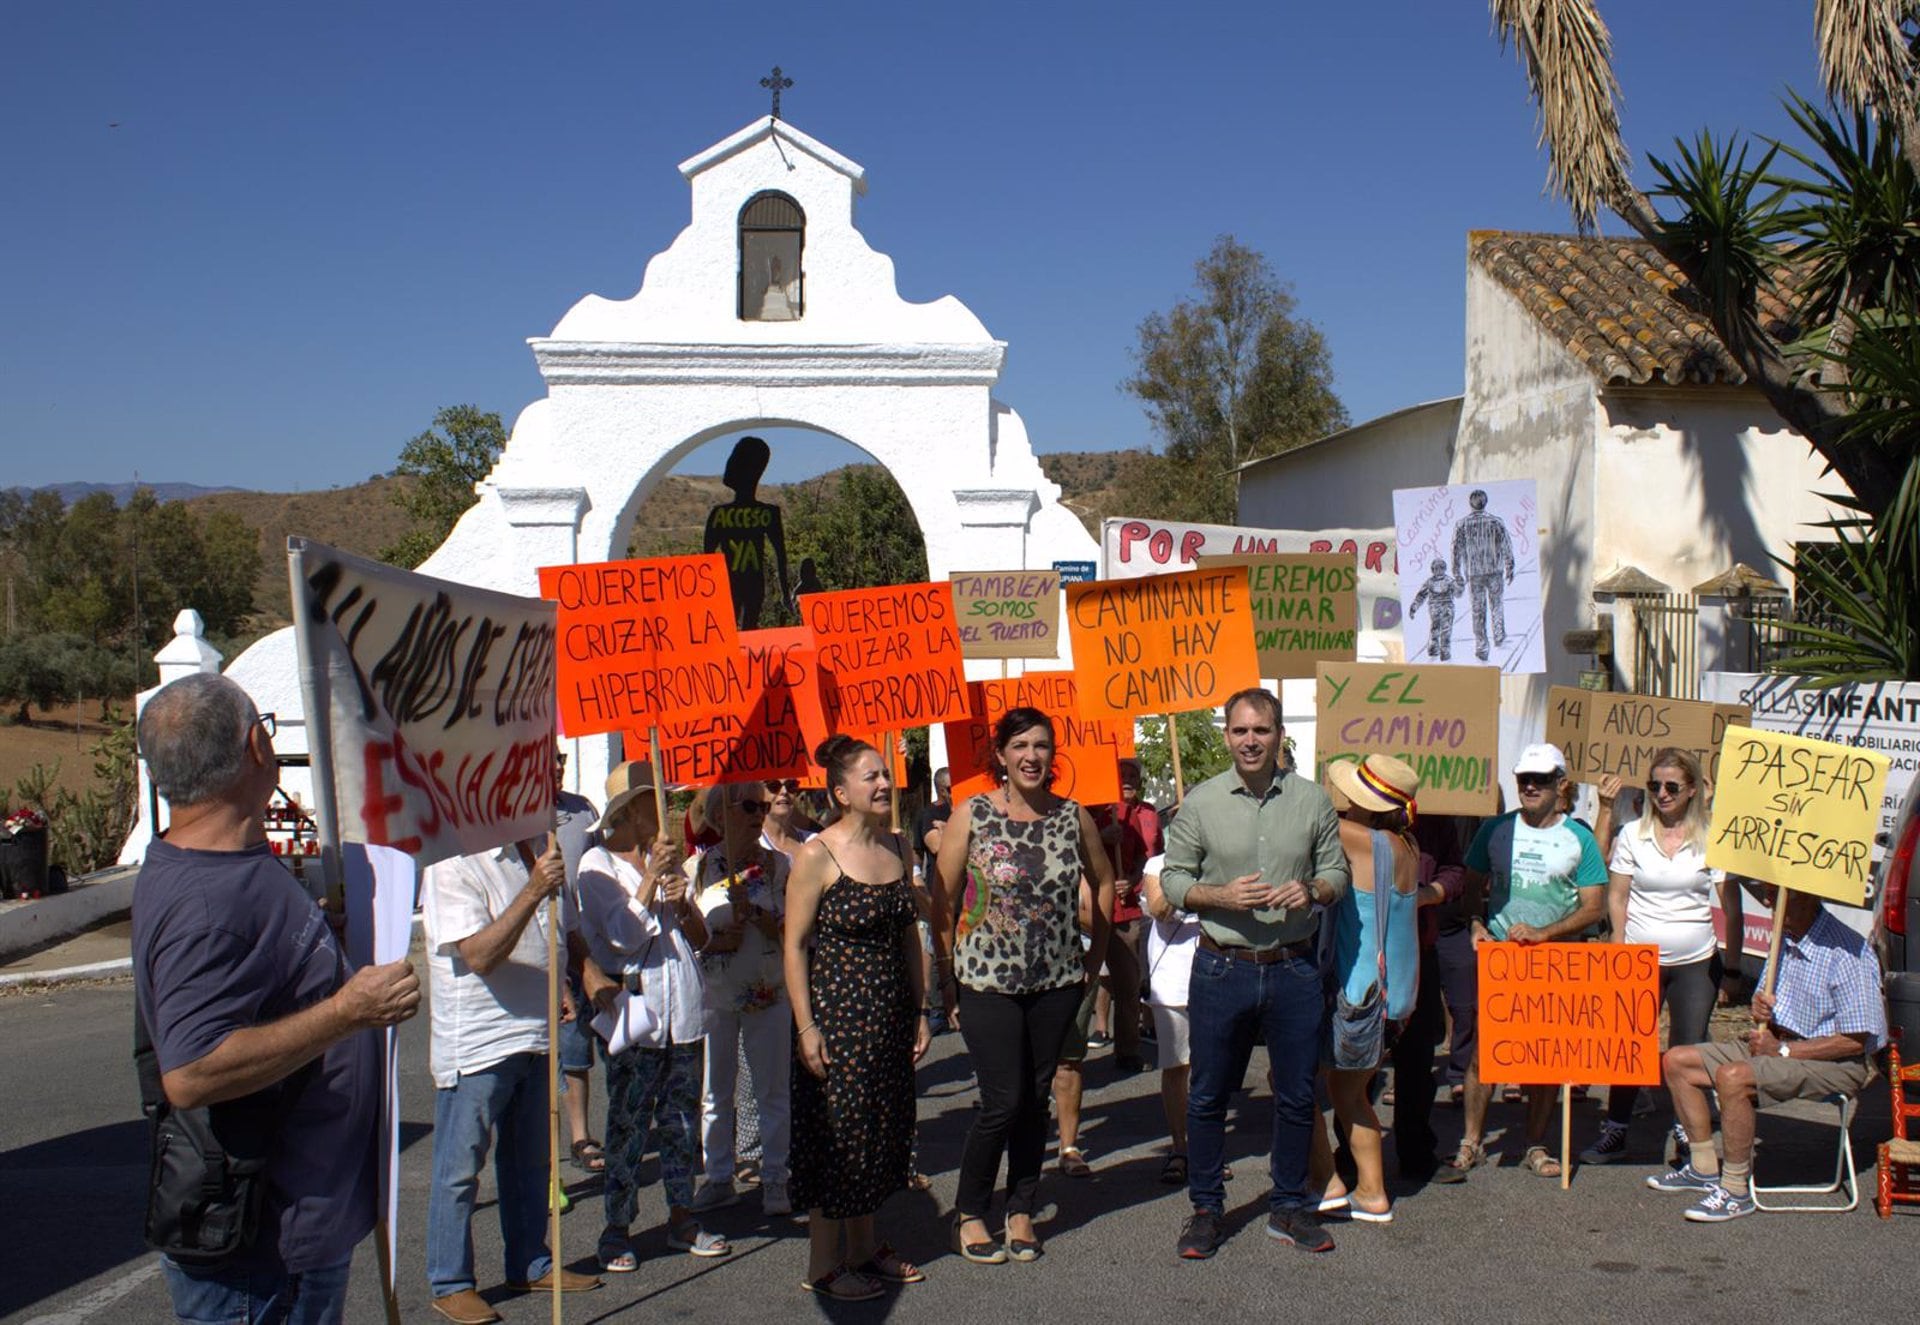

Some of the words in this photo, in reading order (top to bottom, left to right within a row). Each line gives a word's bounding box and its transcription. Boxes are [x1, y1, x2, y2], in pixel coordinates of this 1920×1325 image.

[713, 507, 771, 528] ACCESO
[729, 538, 761, 573] YA
[1119, 521, 1206, 564] POR
[558, 563, 716, 610] QUEREMOS
[954, 575, 1056, 598] TAMBIEN
[1075, 575, 1236, 629] CAMINANTE
[812, 589, 945, 635] QUEREMOS
[967, 600, 1038, 619] SOMOS
[986, 618, 1049, 641] PUERTO
[565, 616, 674, 662] CRUZAR
[687, 609, 725, 645] LA
[818, 632, 912, 675] CRUZAR
[926, 626, 957, 654] LA
[1104, 631, 1142, 667] NO
[1172, 620, 1221, 657] HAY
[575, 656, 745, 722] HIPERRONDA
[825, 667, 966, 726] HIPERRONDA
[1105, 660, 1215, 710] CAMINO
[1324, 674, 1350, 709] Y
[1366, 672, 1424, 704] EL
[765, 694, 798, 728] LA
[1340, 712, 1466, 748] CAMINO
[1557, 698, 1581, 730] 14
[1603, 700, 1671, 738] AÑOS
[1735, 740, 1875, 811] PASEAR
[1716, 815, 1867, 882] ARRIESGAR
[1487, 948, 1654, 983] QUEREMOS
[1486, 992, 1605, 1029] CAMINAR
[1614, 988, 1657, 1037] NO
[1492, 1037, 1644, 1075] CONTAMINAR
